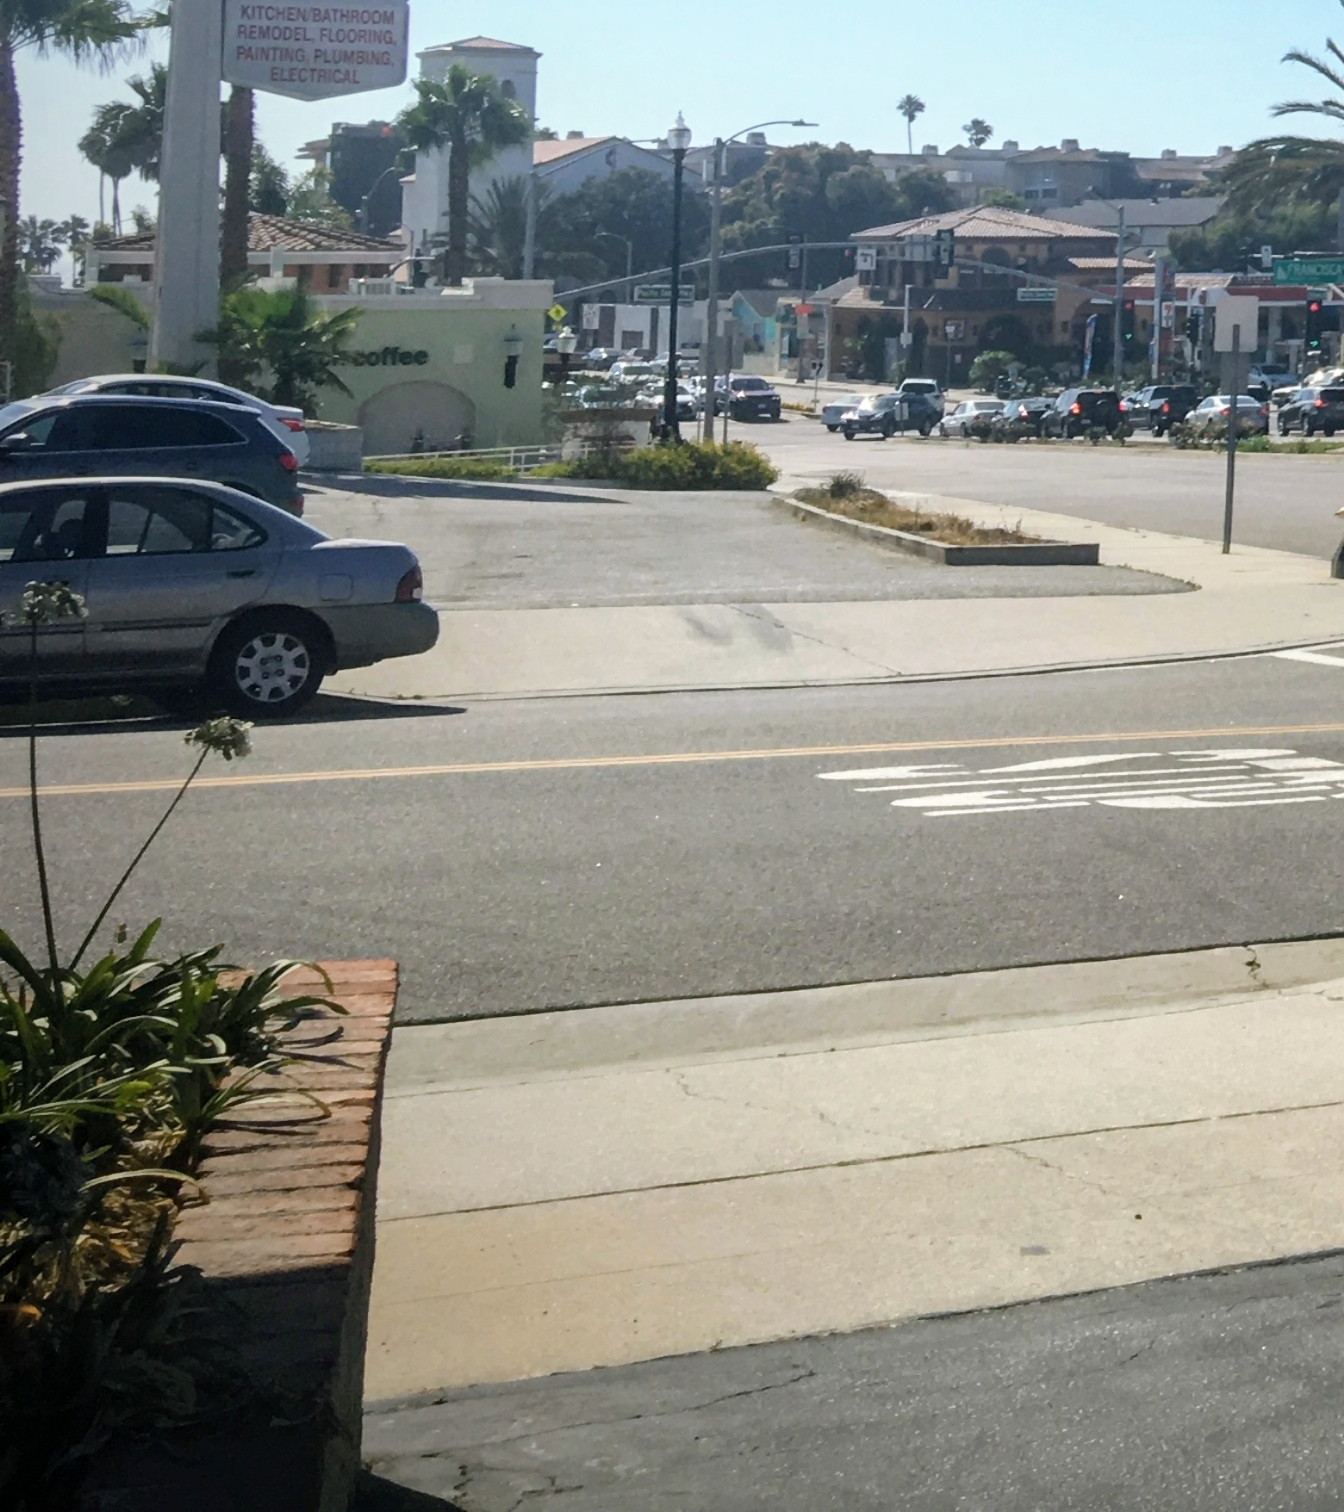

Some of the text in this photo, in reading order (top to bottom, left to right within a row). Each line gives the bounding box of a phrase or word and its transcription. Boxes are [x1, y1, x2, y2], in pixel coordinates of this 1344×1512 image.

[240, 4, 395, 25] KITCHEN/BATHROOM
[319, 28, 397, 46] FLOORING,
[313, 49, 395, 67] PLUMBING,
[270, 67, 360, 84] ELECTRICAL
